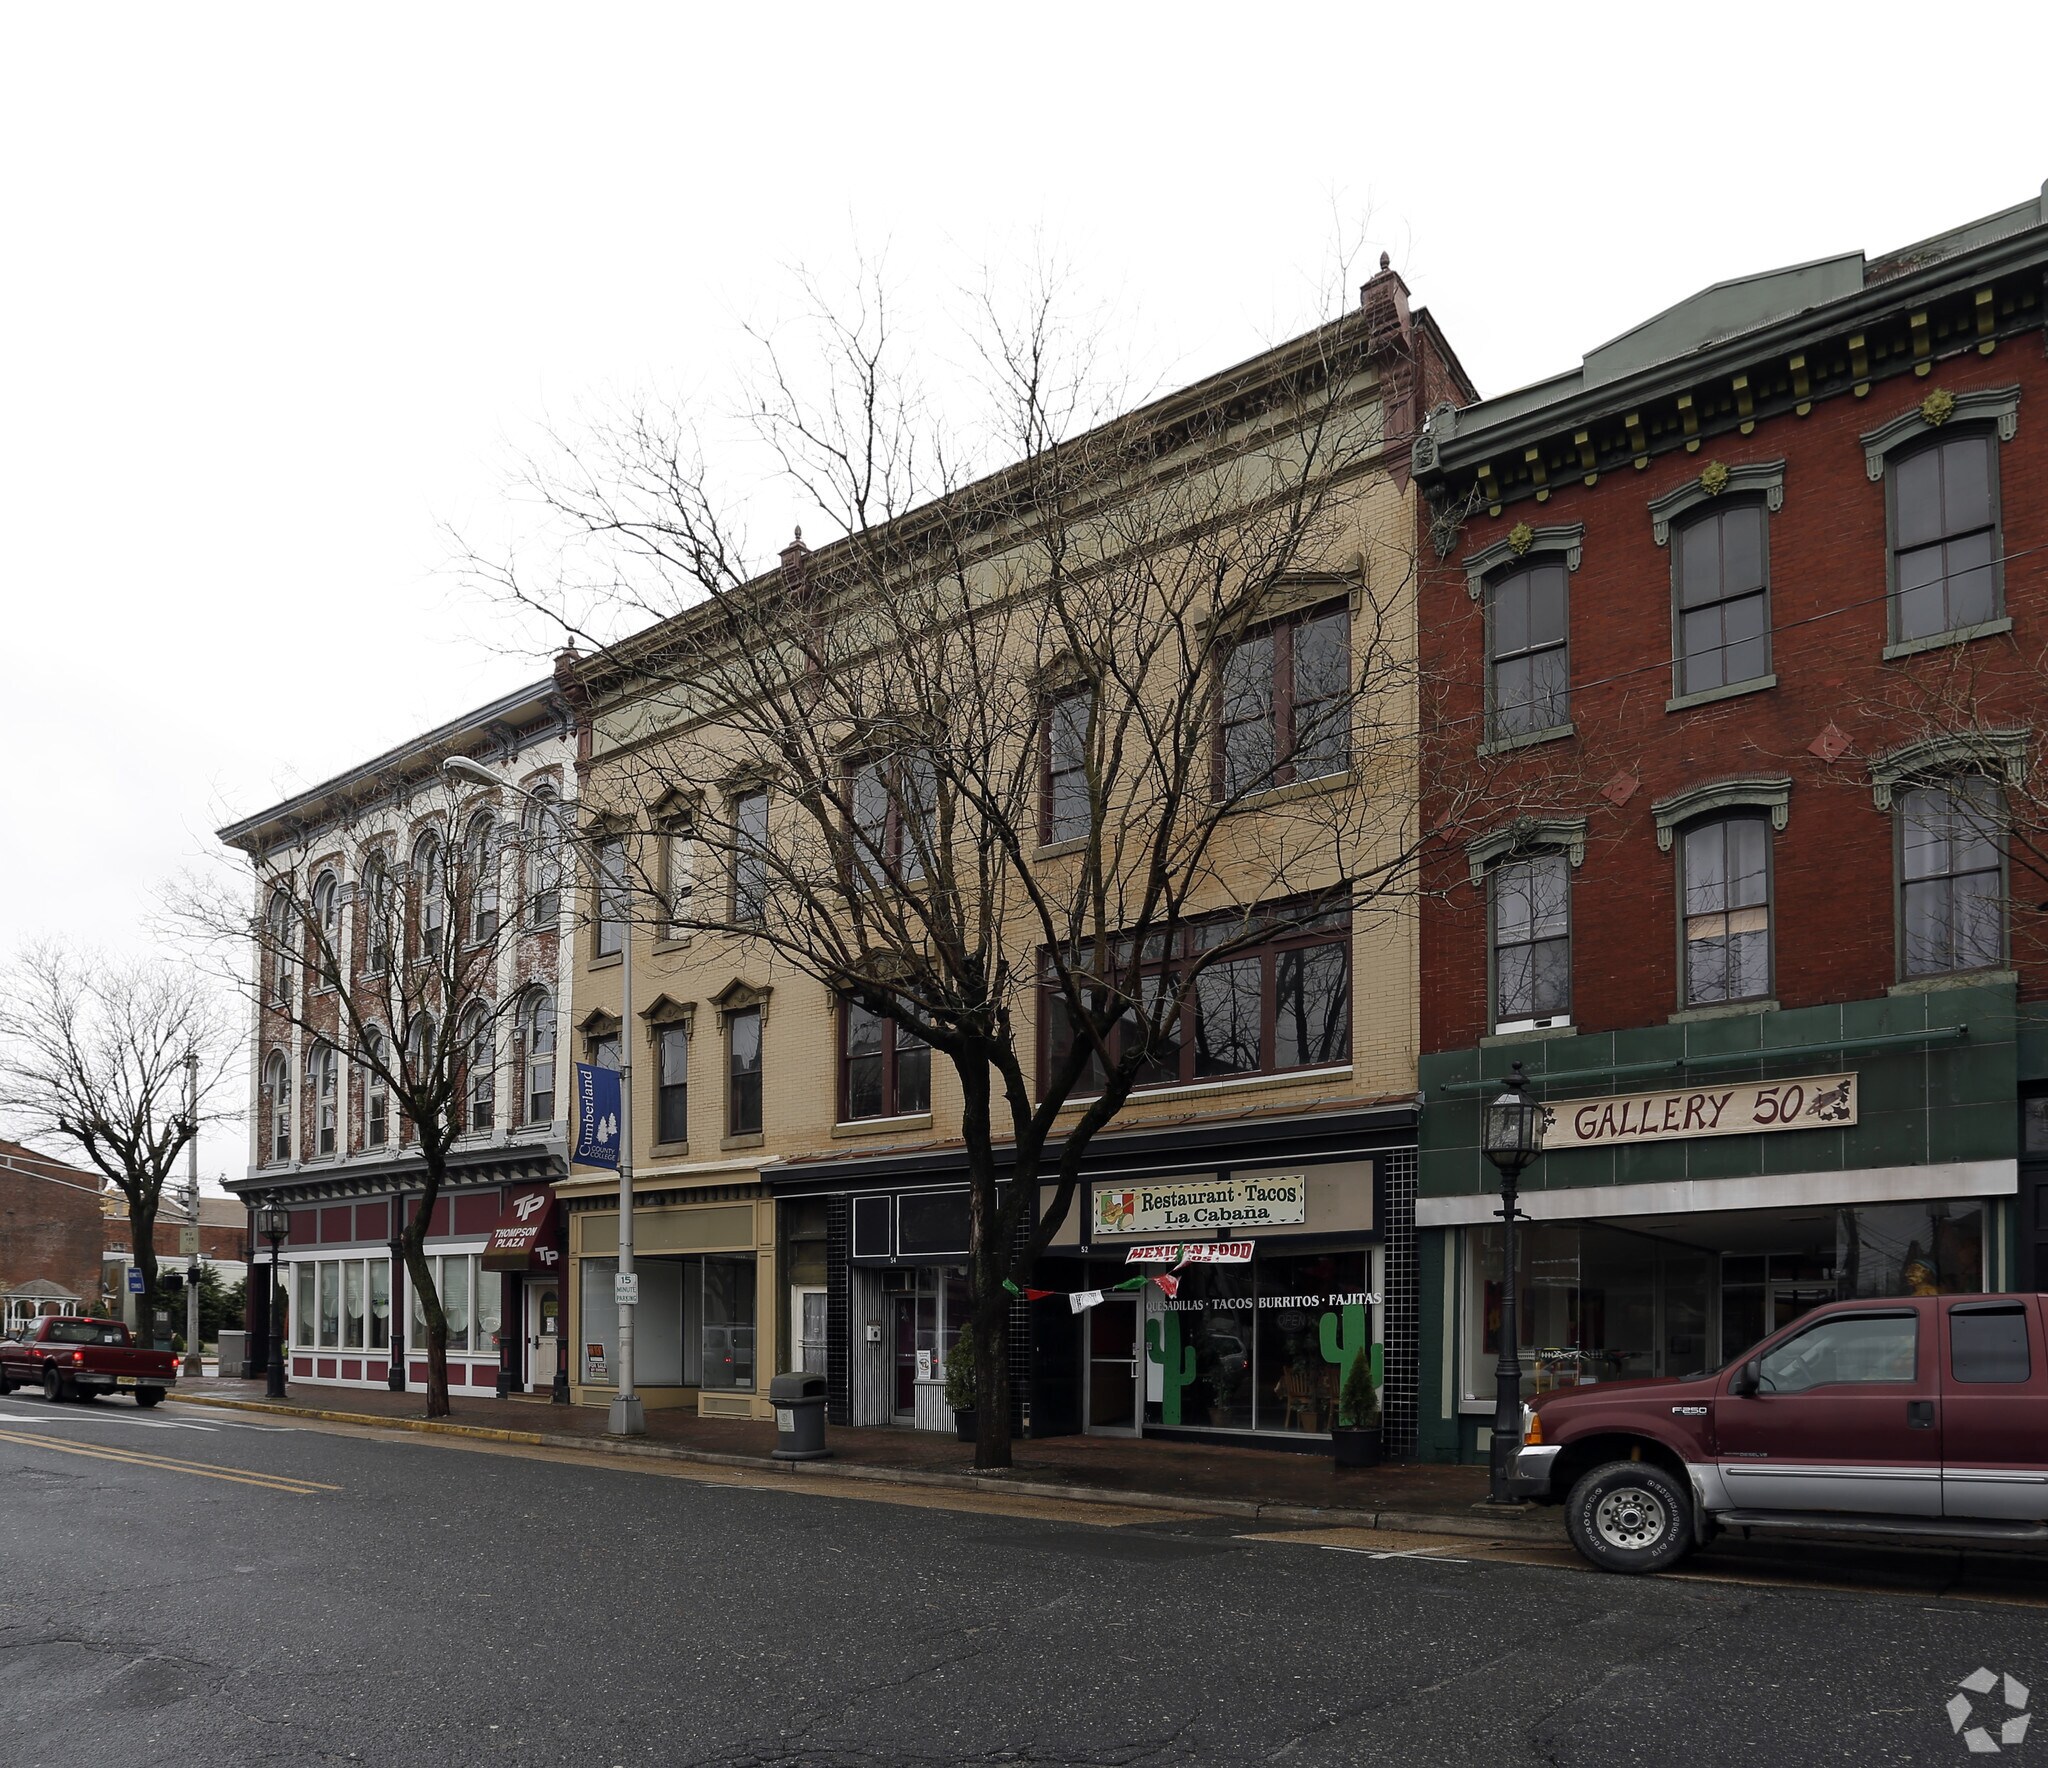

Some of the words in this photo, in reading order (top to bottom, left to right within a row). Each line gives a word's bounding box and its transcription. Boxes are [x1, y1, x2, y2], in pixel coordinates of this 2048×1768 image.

[579, 1070, 594, 1156] Cumberland
[1574, 1091, 1735, 1140] GALLERY
[1752, 1085, 1804, 1125] 50
[590, 1151, 616, 1161] COLLEGE
[591, 1145, 615, 1155] COUNTY
[513, 1193, 545, 1221] TP
[1141, 1186, 1235, 1212] Restaurant
[1245, 1185, 1297, 1203] Tacos
[1164, 1210, 1190, 1224] La
[1193, 1204, 1270, 1222] Cabaña
[494, 1226, 538, 1238] THOMPSON
[495, 1237, 525, 1248] PLAZA
[1208, 1243, 1252, 1259] FOOD
[534, 1246, 559, 1265] TP
[621, 1276, 631, 1284] 15
[1146, 1299, 1204, 1313] QUESADILLAS
[1212, 1297, 1253, 1309] TACOS
[1258, 1295, 1320, 1308] BURRITOS
[1328, 1292, 1382, 1306] FAJITAS
